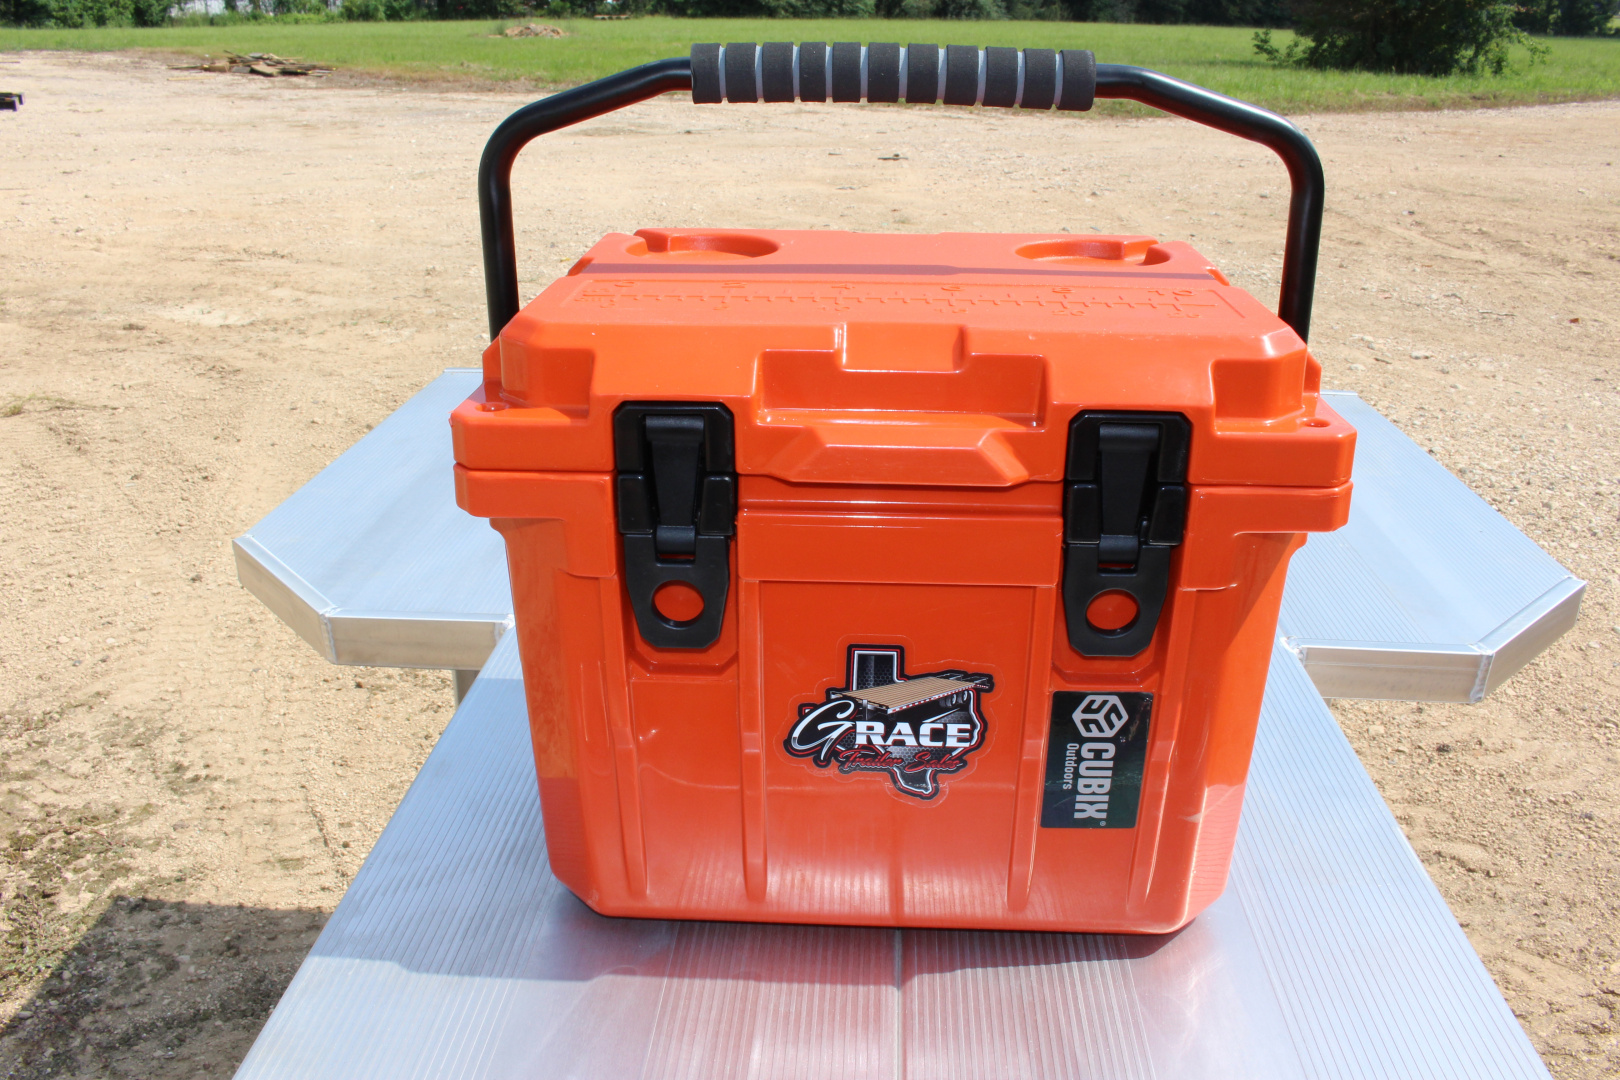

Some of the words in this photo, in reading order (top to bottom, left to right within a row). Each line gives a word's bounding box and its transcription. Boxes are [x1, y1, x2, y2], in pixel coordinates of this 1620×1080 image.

[791, 699, 972, 761] GRACE
[838, 749, 904, 770] Trailer
[904, 751, 963, 773] Sales
[1062, 743, 1080, 790] Outdoors
[1073, 742, 1116, 819] CUBIX
